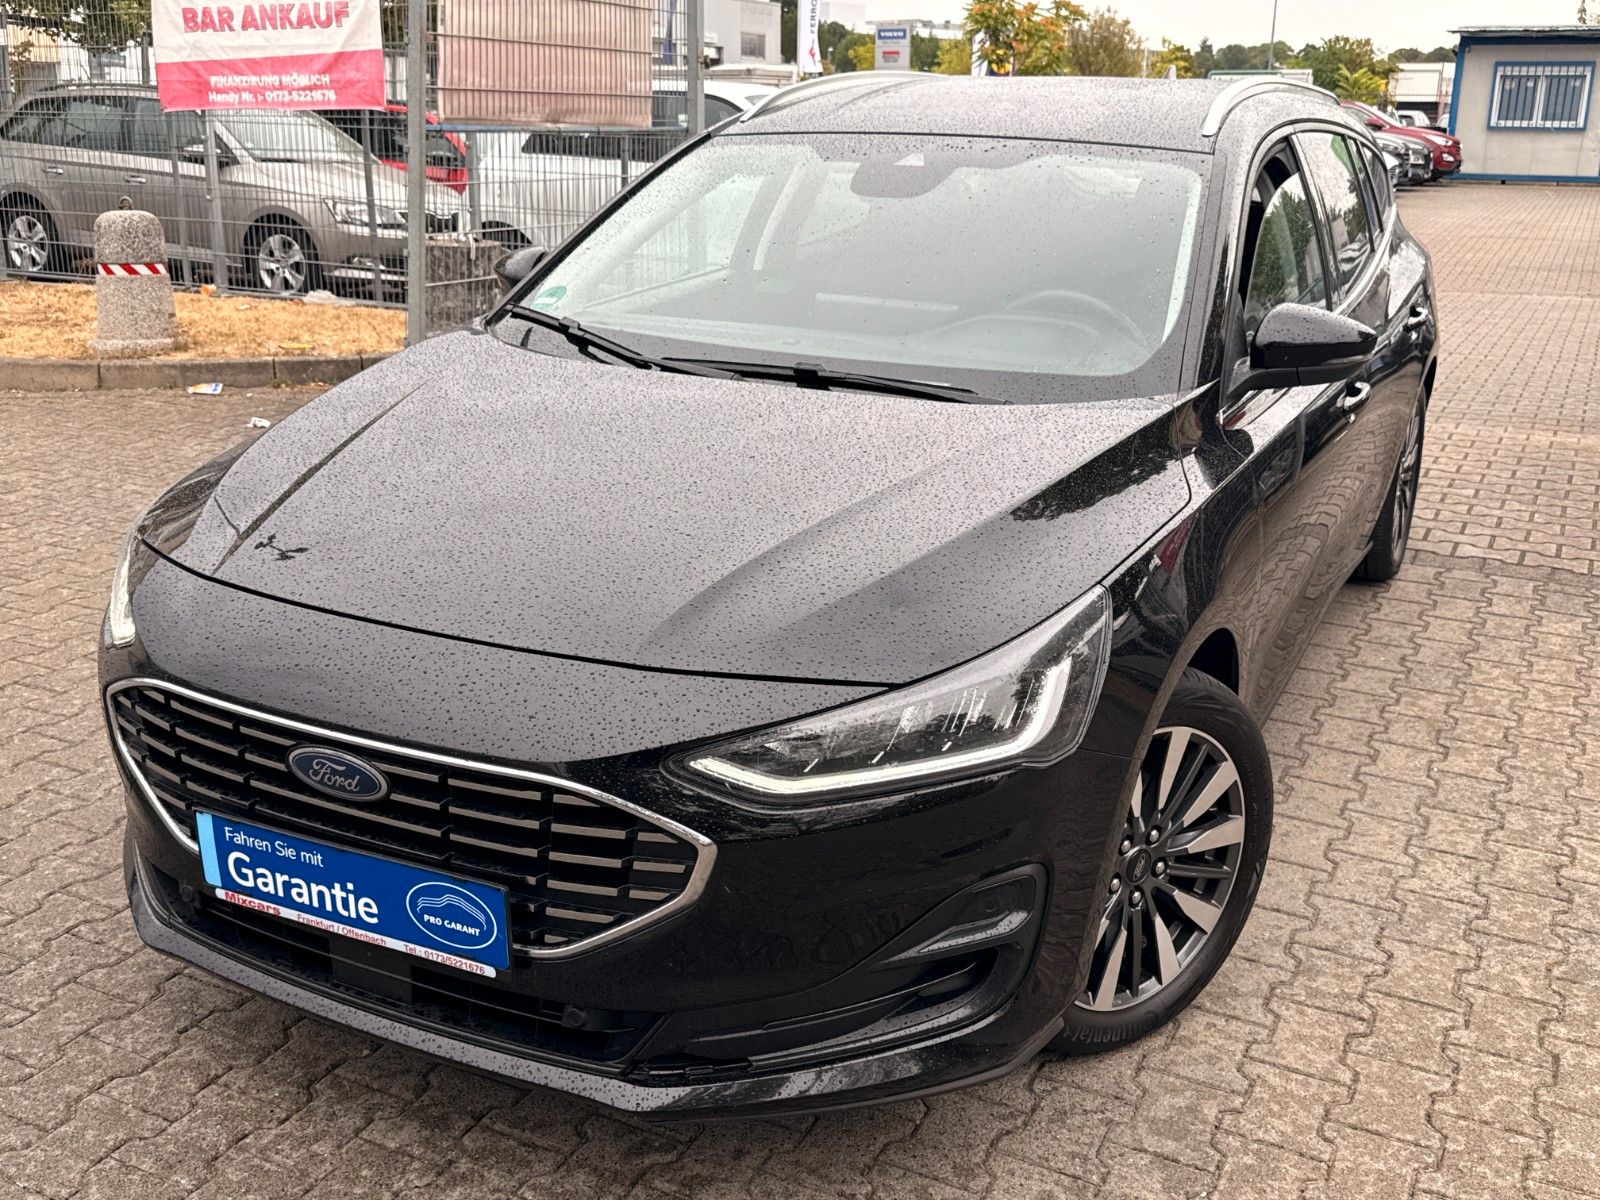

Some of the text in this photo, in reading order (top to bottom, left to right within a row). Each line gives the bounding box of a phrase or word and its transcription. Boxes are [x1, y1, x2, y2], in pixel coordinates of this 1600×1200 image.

[181, 1, 350, 33] BAR ANKAUF
[208, 91, 240, 104] Handy
[308, 758, 361, 793] Ford
[224, 826, 324, 868] Fahren Sie mit
[227, 851, 379, 924] Garantie
[224, 891, 282, 917] Mixcars
[297, 913, 335, 932] Frankfurt
[341, 926, 387, 946] Offenbach
[424, 950, 486, 975] 0173/5221676
[423, 914, 481, 937] PRO GARANT
